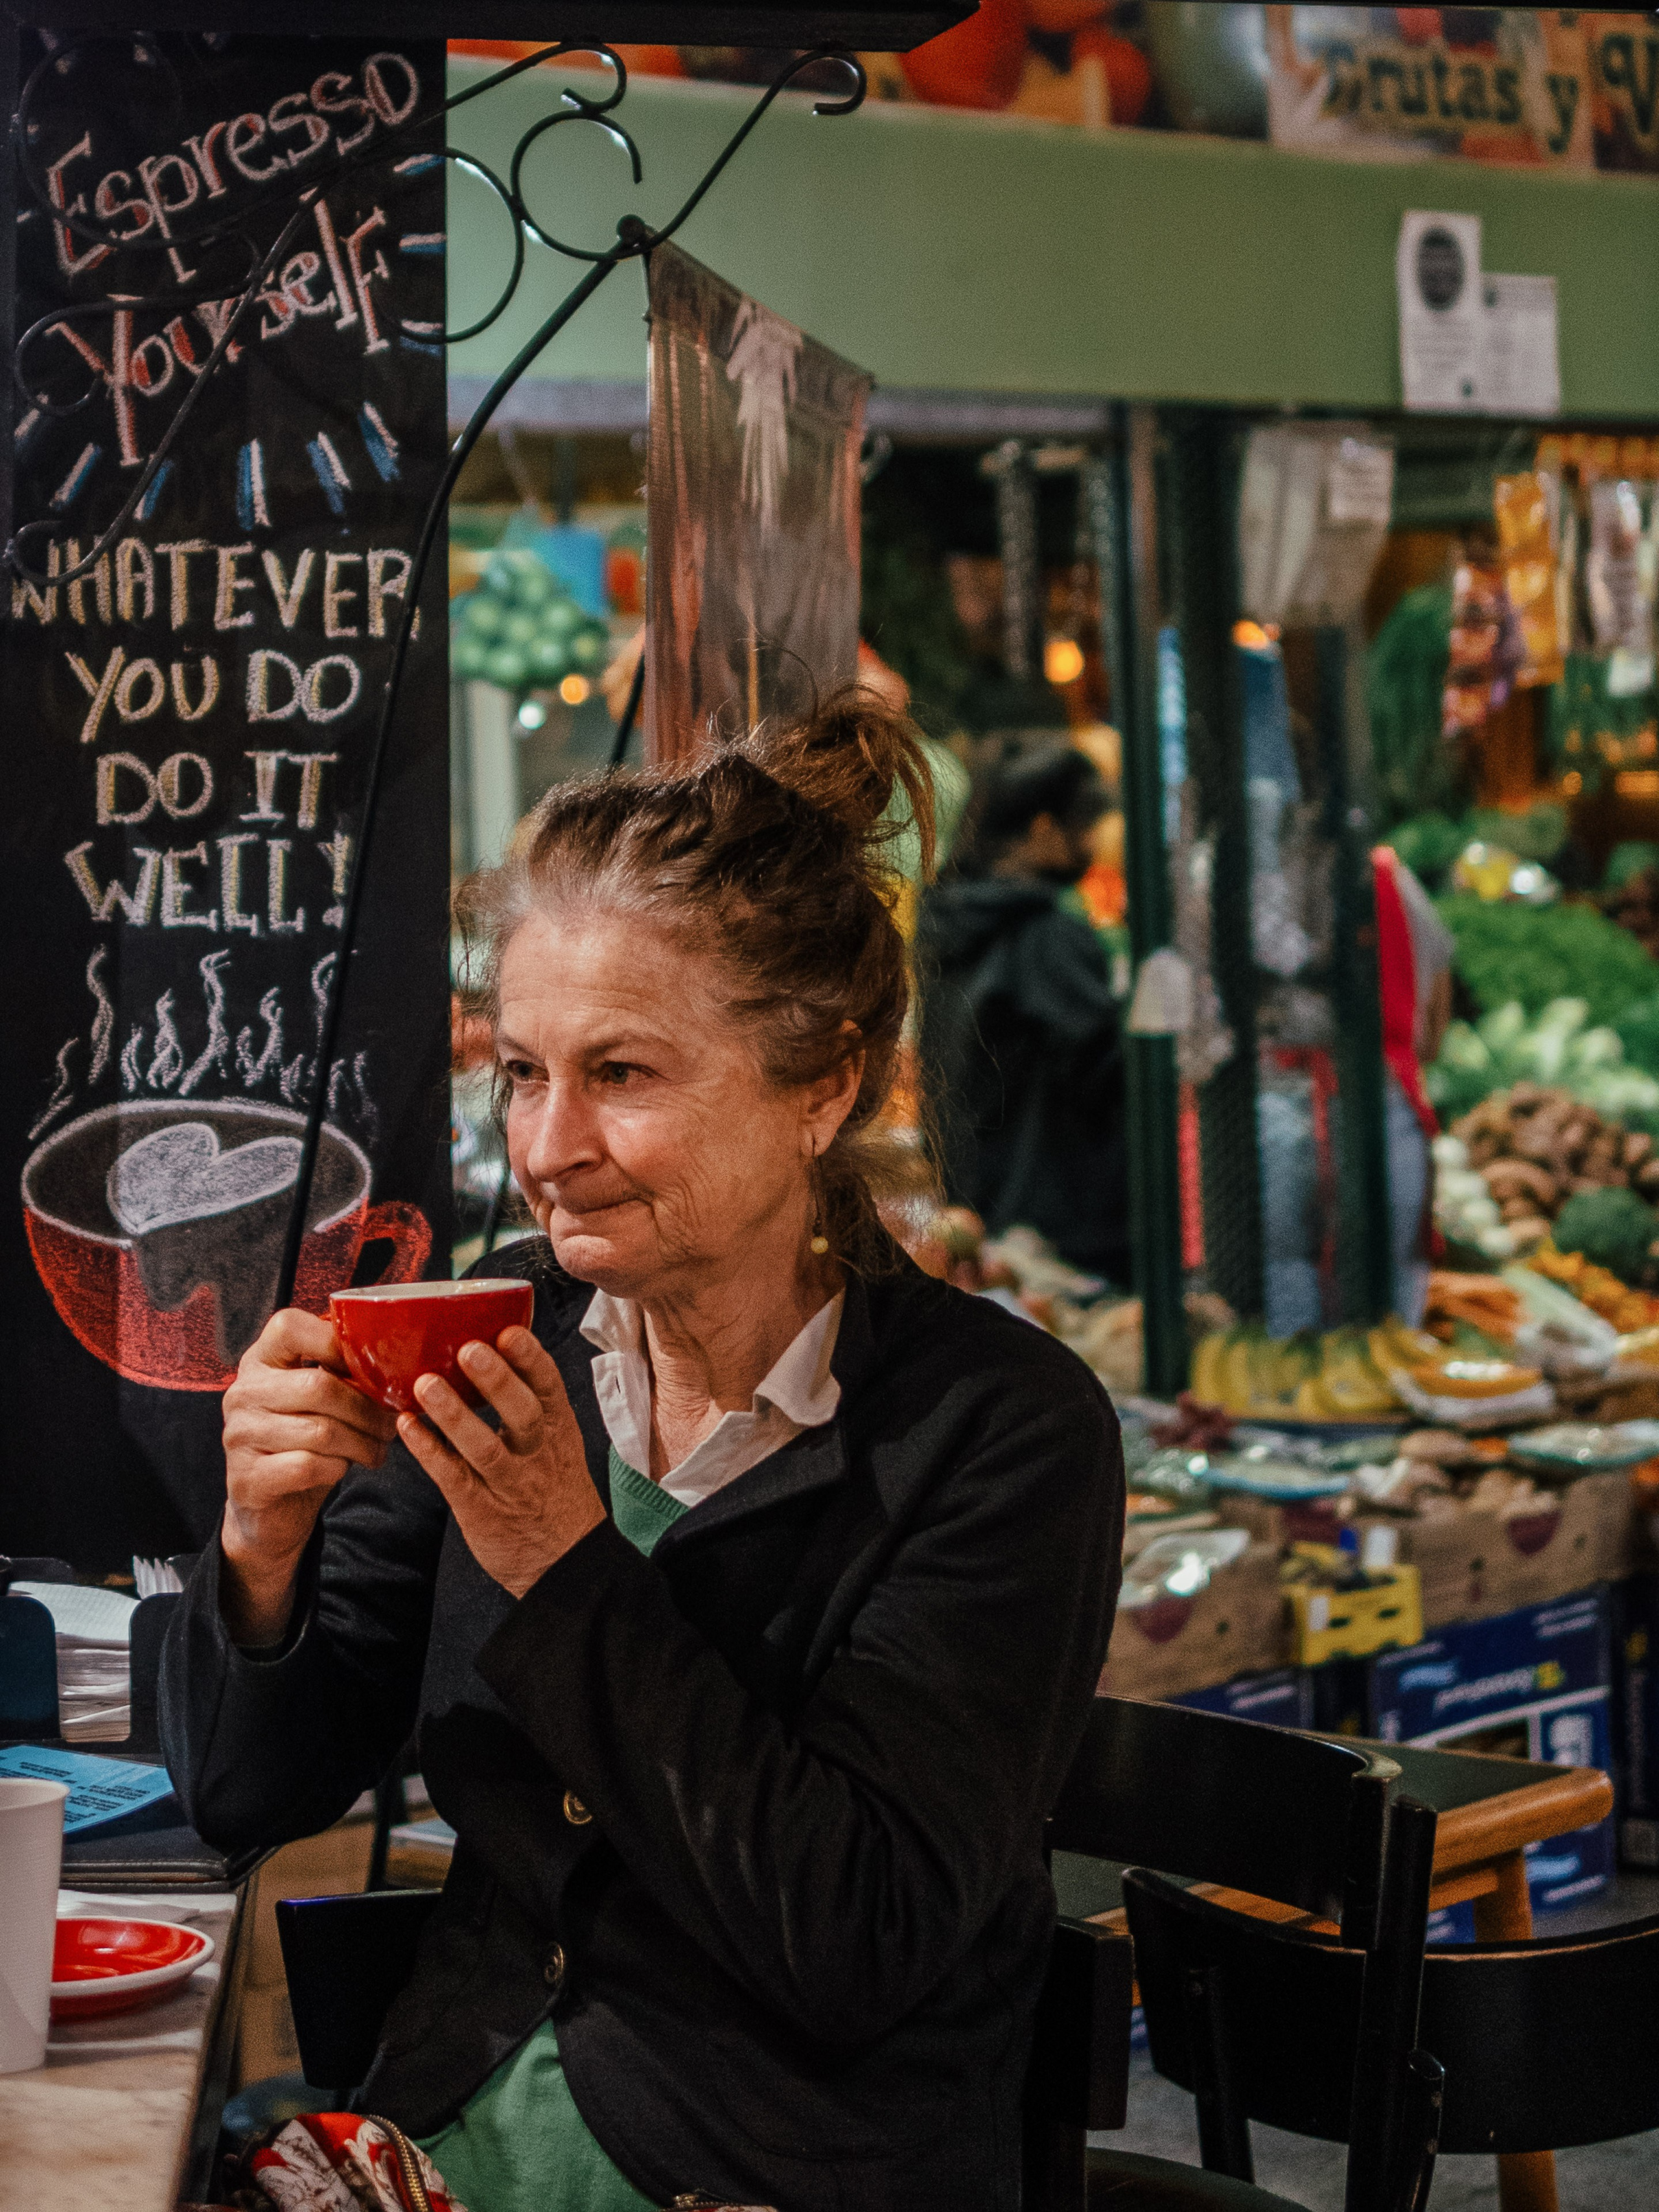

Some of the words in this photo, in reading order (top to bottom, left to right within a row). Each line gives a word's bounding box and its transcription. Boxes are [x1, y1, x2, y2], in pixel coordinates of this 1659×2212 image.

[48, 52, 419, 283] Espresso
[12, 537, 421, 640] WHATEVER
[65, 646, 220, 743] YOU
[245, 649, 361, 723] DO
[97, 752, 214, 825] DO
[238, 750, 338, 830] IT
[64, 832, 352, 937] WELL!
